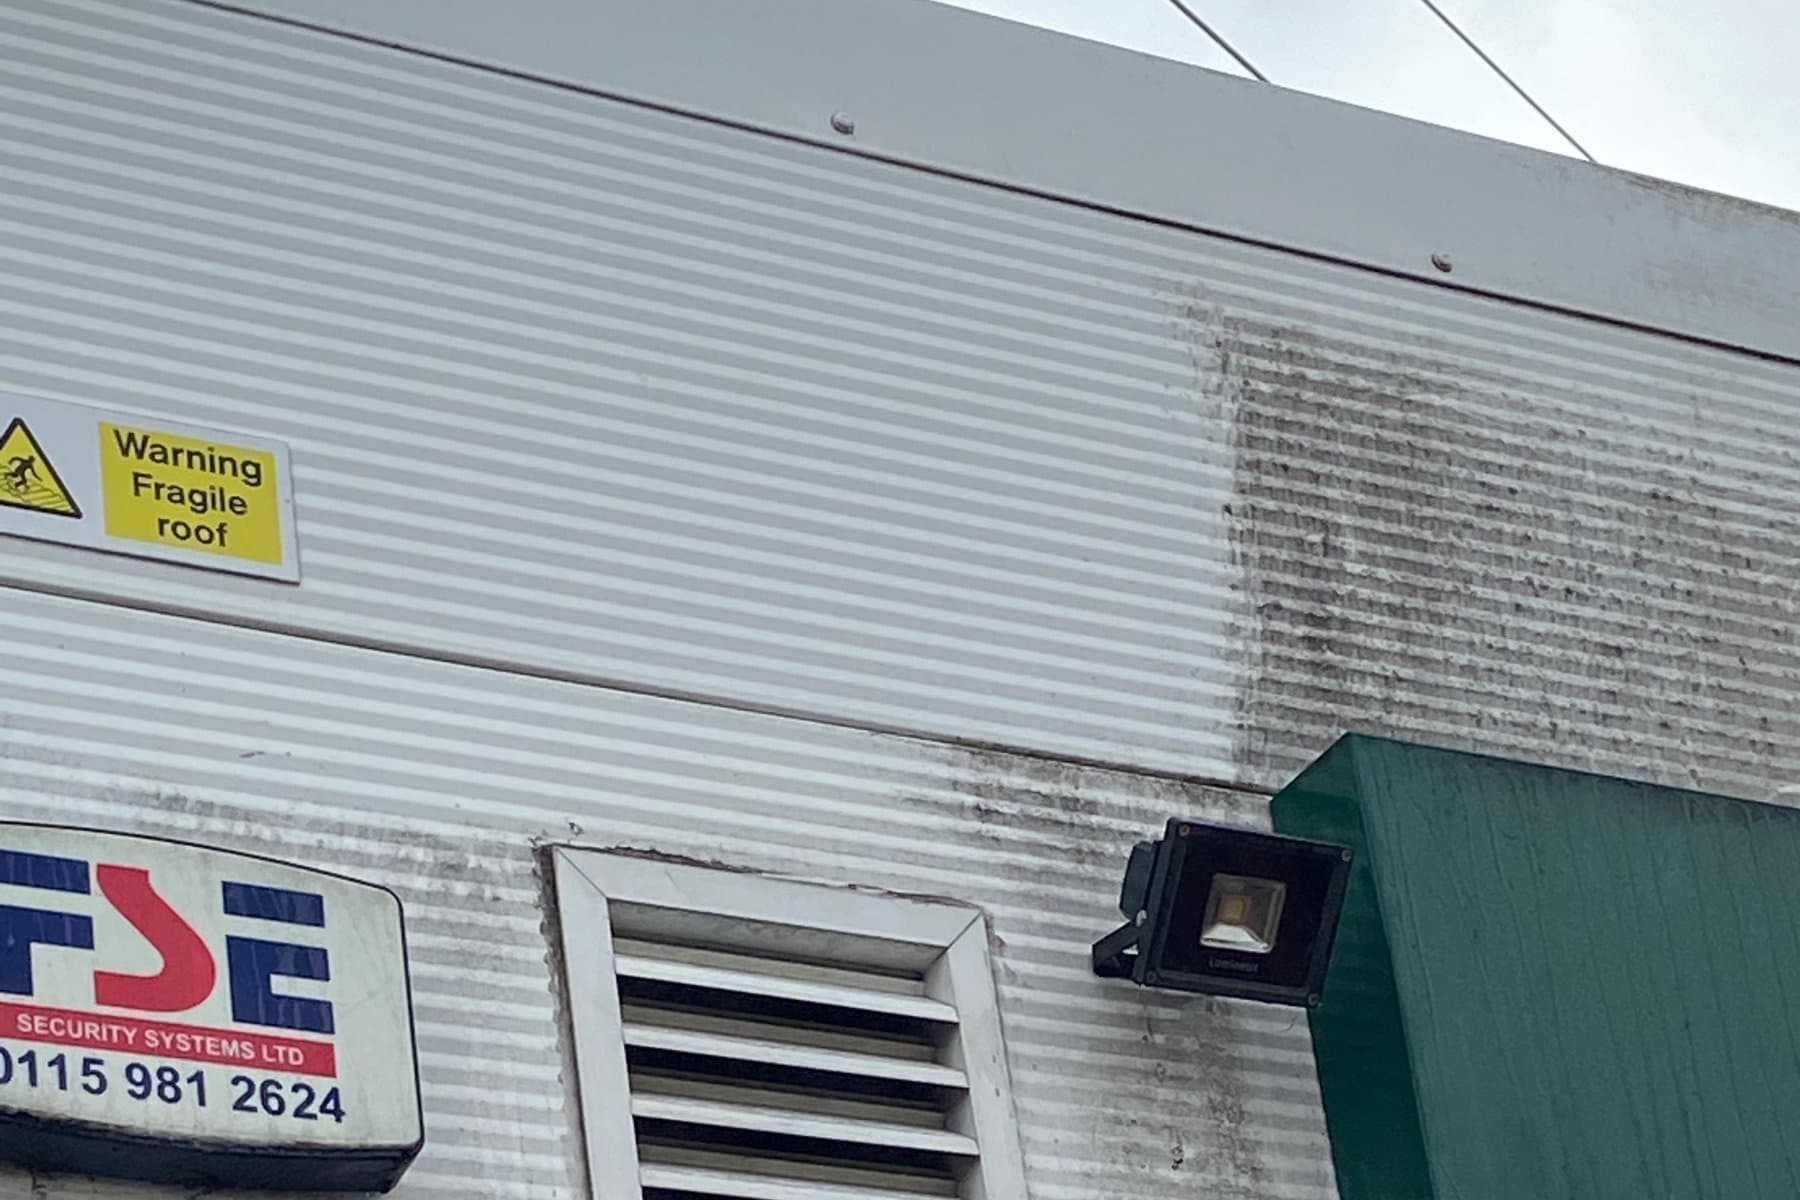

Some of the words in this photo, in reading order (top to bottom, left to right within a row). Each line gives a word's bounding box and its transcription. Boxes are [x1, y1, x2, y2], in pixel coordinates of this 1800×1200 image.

[113, 428, 262, 487] Warning
[132, 472, 248, 516] Fragile
[157, 518, 228, 547] roof
[0, 849, 335, 1035] FSE
[16, 1012, 138, 1044] SECURITY
[144, 1029, 255, 1061] SYSTEMS
[262, 1037, 304, 1067] LTD
[125, 1062, 207, 1107] 981
[231, 1075, 346, 1124] 2624
